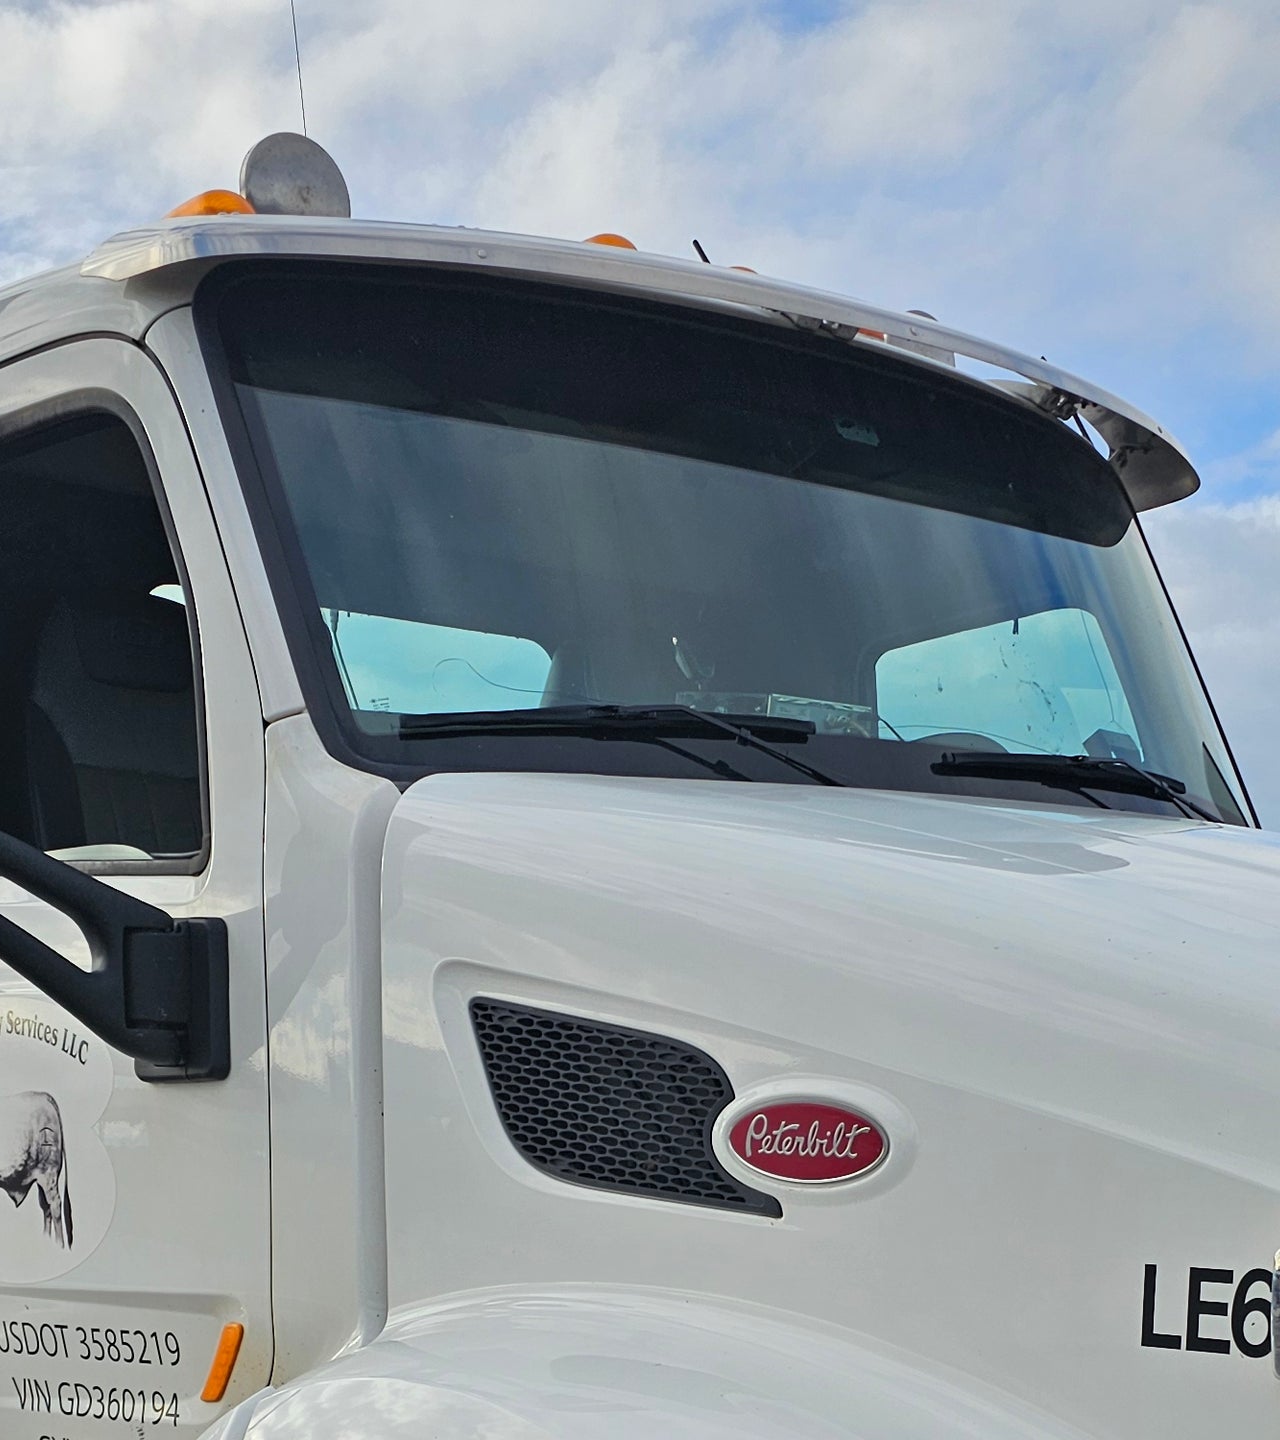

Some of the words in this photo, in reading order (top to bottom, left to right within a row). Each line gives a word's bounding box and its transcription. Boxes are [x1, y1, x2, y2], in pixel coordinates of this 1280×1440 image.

[6, 1010, 59, 1047] Services
[61, 1028, 89, 1065] LLC
[745, 1113, 871, 1159] Peterbilt
[1140, 1263, 1273, 1359] LE6
[75, 1326, 181, 1366] 3585219
[11, 1376, 52, 1414] VIN
[57, 1381, 180, 1427] GD360194
